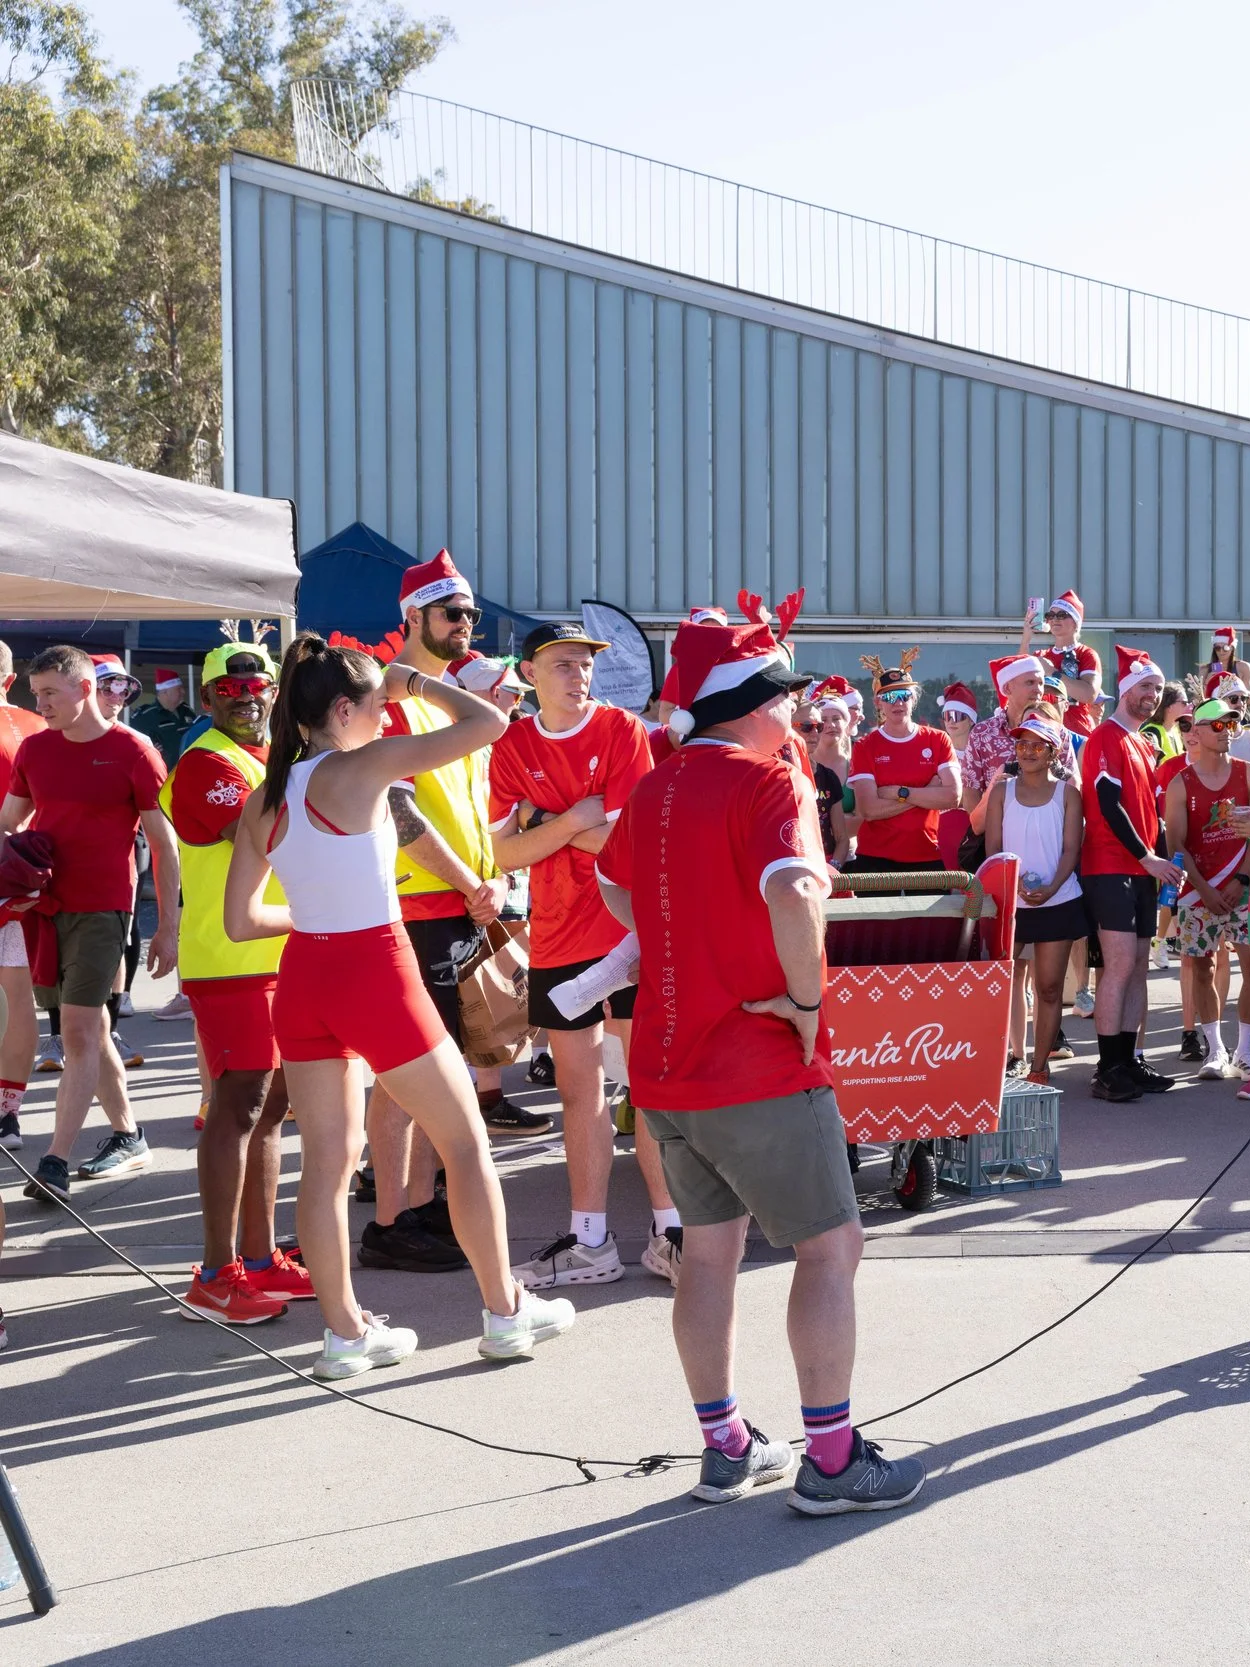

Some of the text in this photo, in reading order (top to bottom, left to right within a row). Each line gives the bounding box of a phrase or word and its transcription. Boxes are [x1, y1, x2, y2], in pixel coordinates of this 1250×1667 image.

[658, 872, 671, 922] KEEP
[661, 965, 677, 1048] MOVING
[828, 1022, 978, 1069] anta Run
[842, 1074, 927, 1087] SUPPORTING RISE ABOVE
